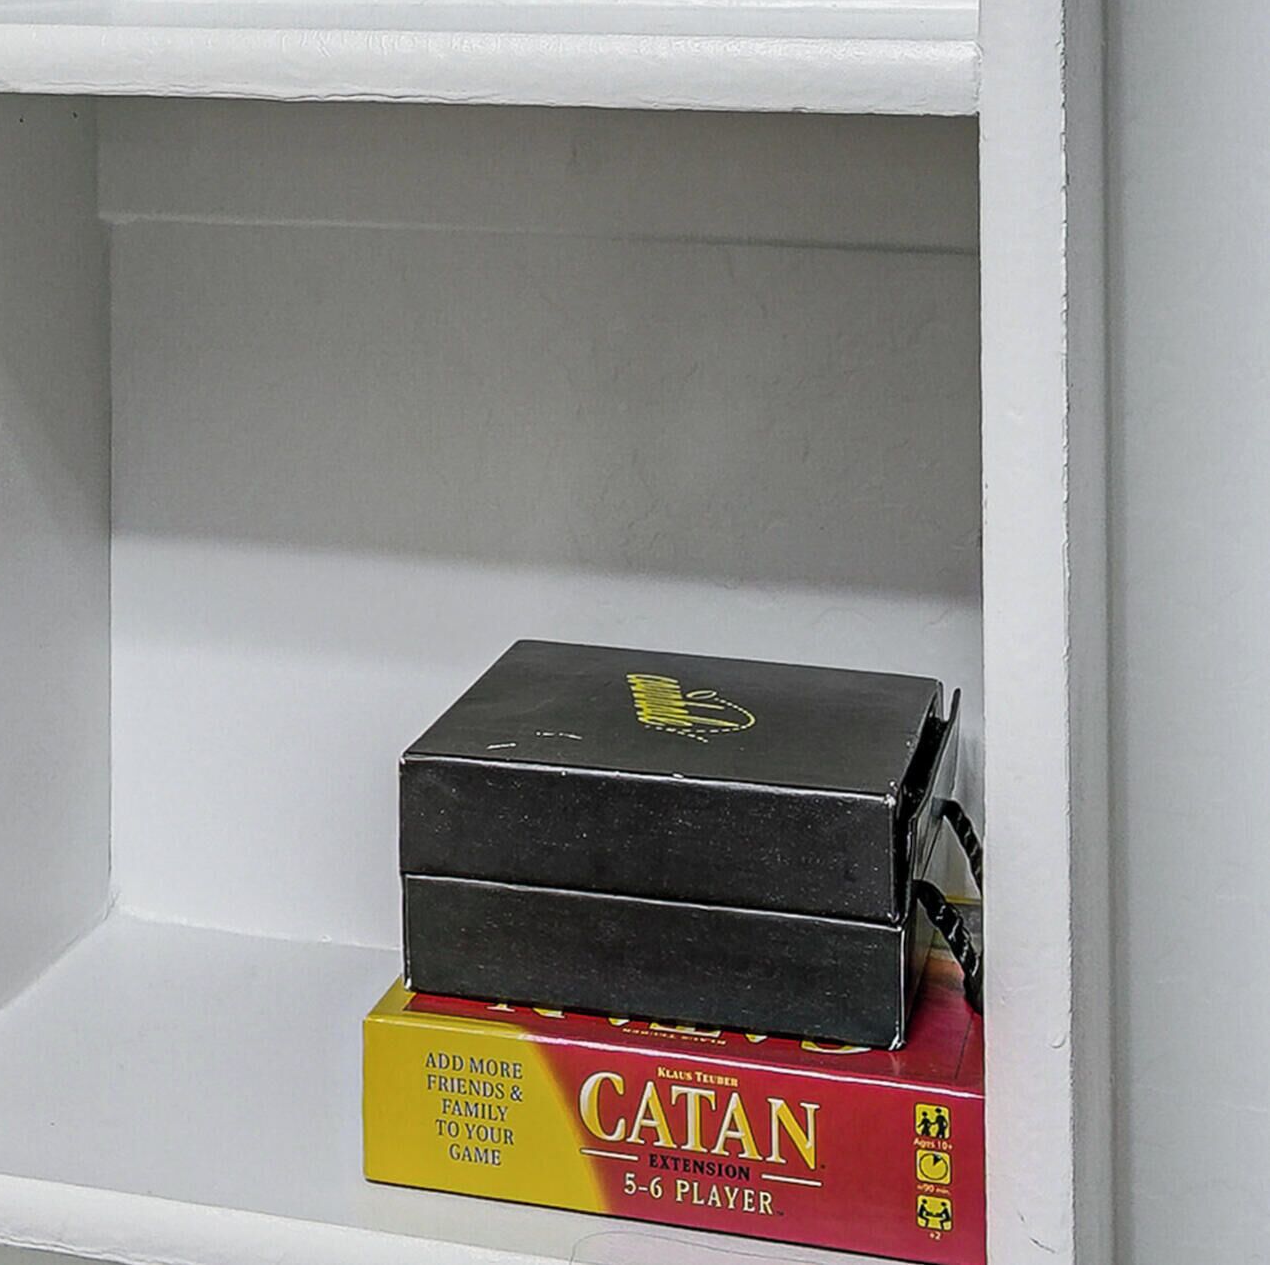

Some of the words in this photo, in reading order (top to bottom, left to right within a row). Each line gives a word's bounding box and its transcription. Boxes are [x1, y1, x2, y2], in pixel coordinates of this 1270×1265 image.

[425, 1052, 464, 1071] ADD
[469, 1056, 523, 1080] MORE
[657, 1066, 693, 1082] KLAUS
[695, 1071, 739, 1087] TEUBER
[427, 1073, 505, 1100] FRIENDS
[510, 1084, 523, 1102] &
[441, 1098, 508, 1122] FAMILY
[579, 1071, 821, 1170] CATAN
[435, 1119, 459, 1138] TO
[464, 1122, 514, 1146] YOUR
[913, 1137, 935, 1149] Ages
[937, 1138, 953, 1150] 10+
[449, 1143, 501, 1166] GAME
[649, 1153, 751, 1181] EXTENSION
[624, 1172, 663, 1199] 5-6
[675, 1178, 774, 1215] PLAYER
[930, 1232, 941, 1241] +2
